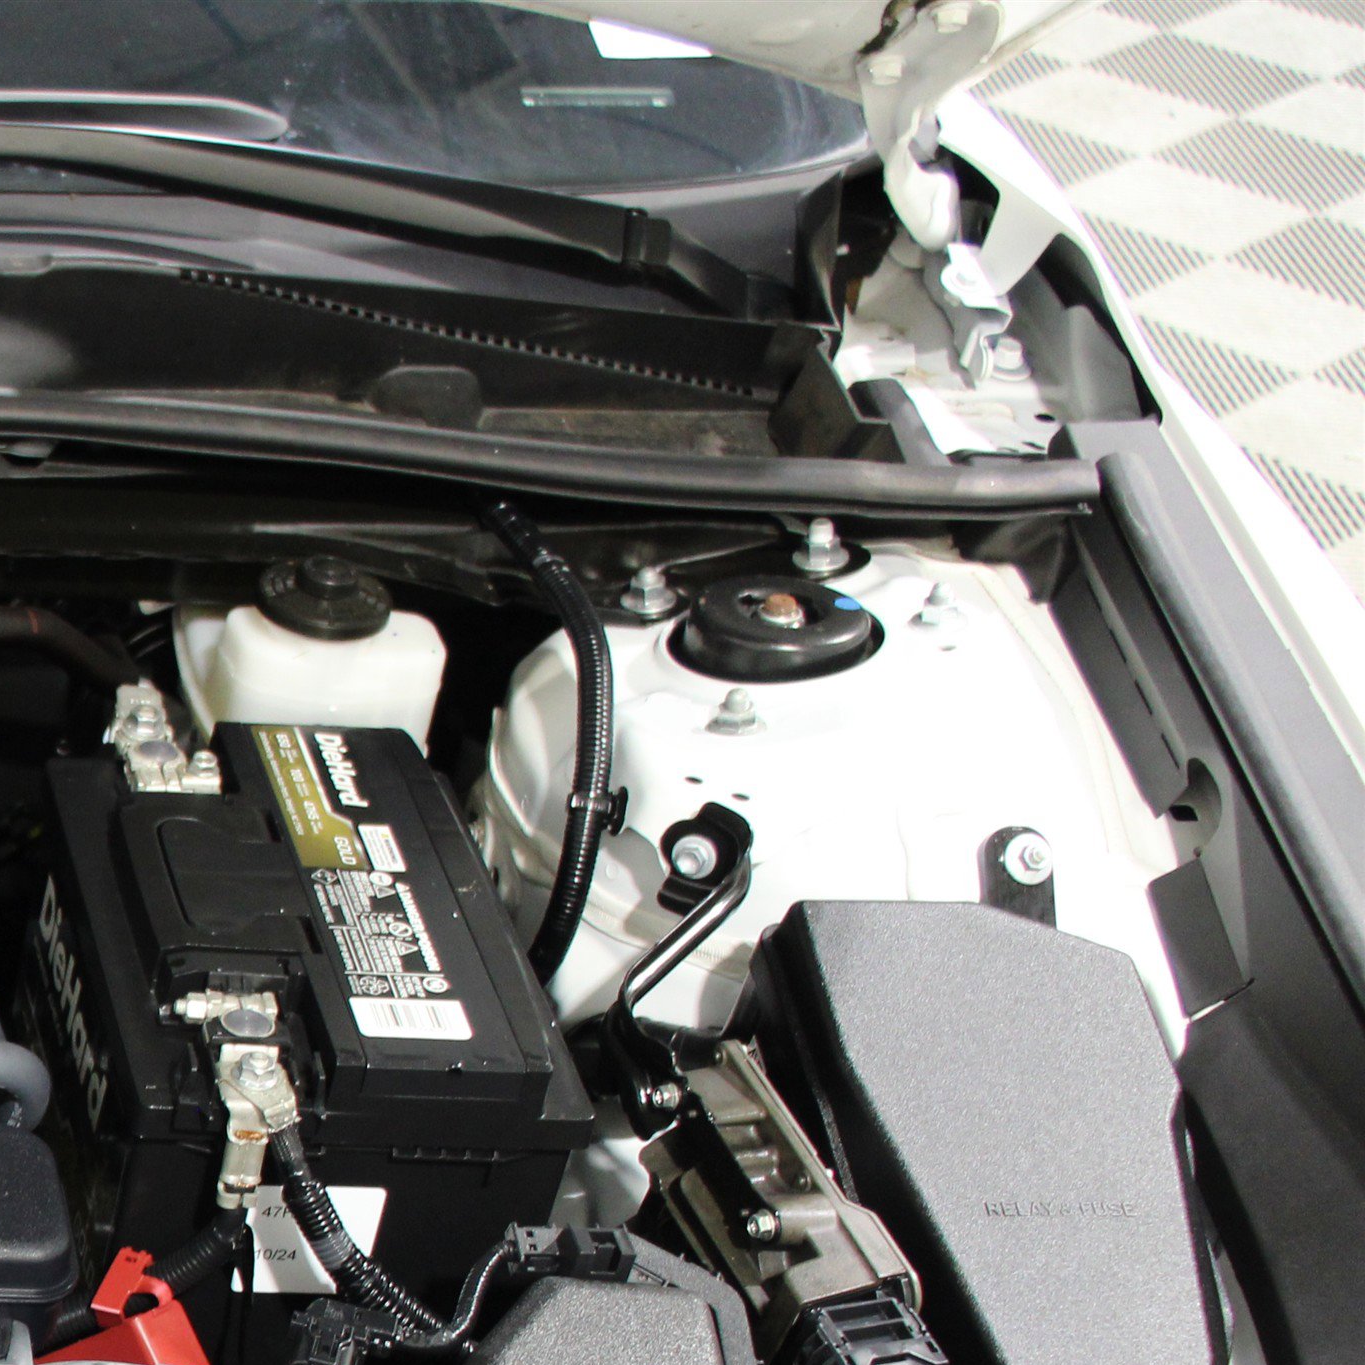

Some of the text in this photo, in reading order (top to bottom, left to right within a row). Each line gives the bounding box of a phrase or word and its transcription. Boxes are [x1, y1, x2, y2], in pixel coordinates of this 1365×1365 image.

[315, 732, 369, 808] DieHard
[334, 835, 357, 866] GOLD
[39, 874, 109, 1134] DieHard
[983, 1200, 1137, 1218] RELAY & FUSE
[256, 1248, 297, 1260] 10/24
